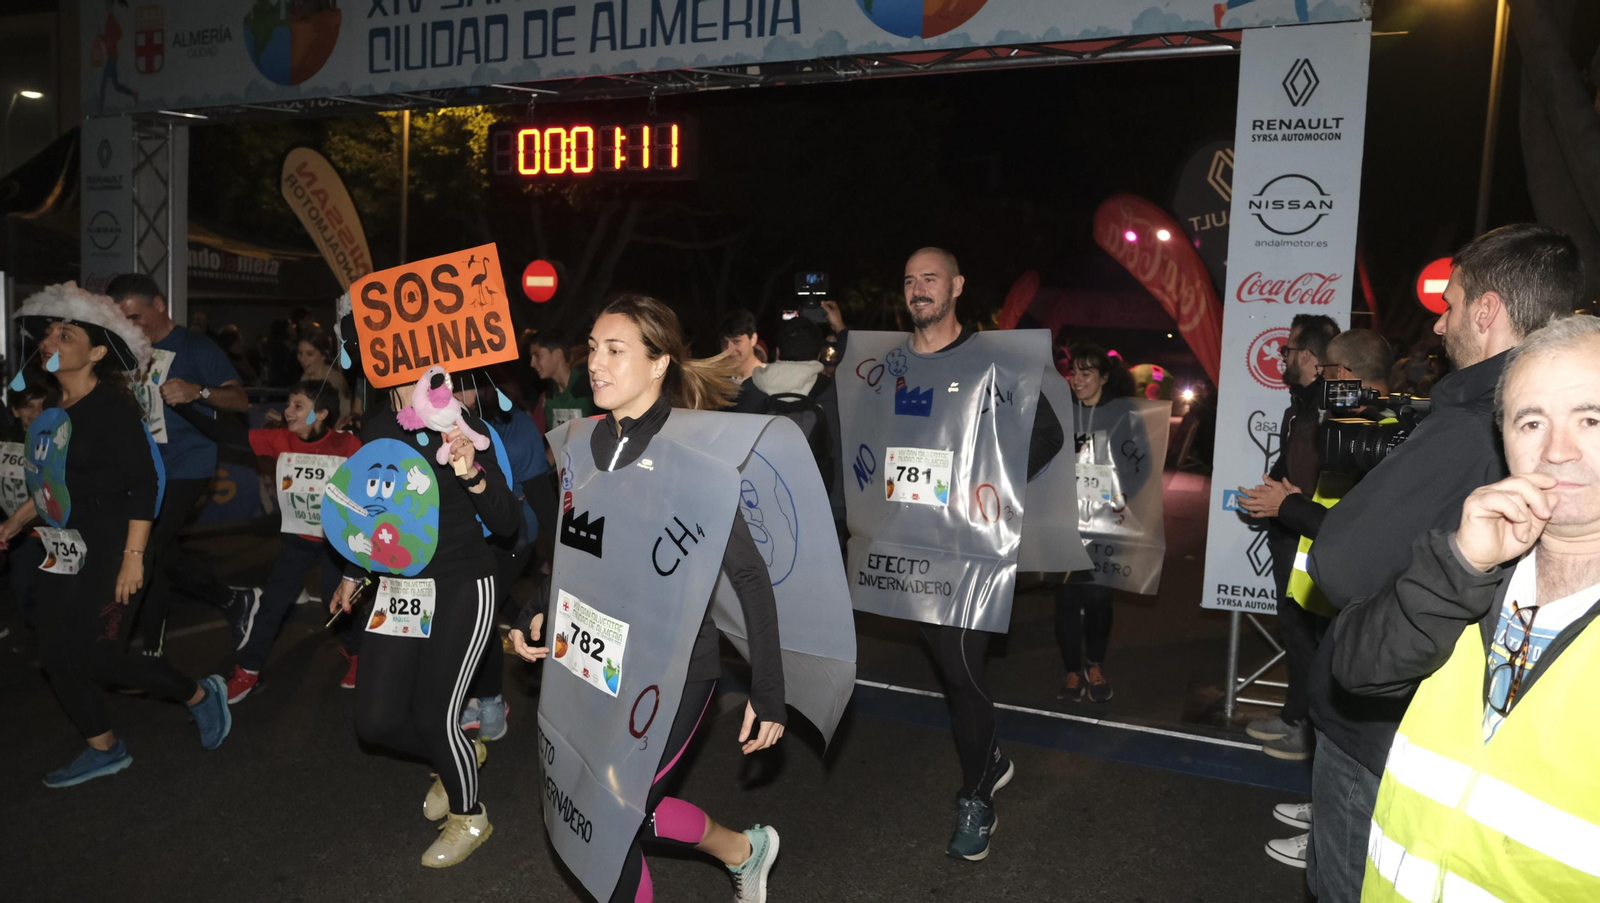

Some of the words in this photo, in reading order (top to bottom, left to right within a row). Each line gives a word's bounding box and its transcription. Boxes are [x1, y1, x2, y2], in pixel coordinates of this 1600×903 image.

[368, 13, 508, 74] CIUDAD
[523, 5, 576, 60] DE
[1252, 117, 1344, 131] RENAULT
[1251, 133, 1279, 142] SYRSA
[1281, 132, 1342, 142] AUTOMOCION
[1248, 199, 1333, 210] NISSAN
[1254, 239, 1328, 248] andalmotor.es
[1236, 271, 1343, 305] Coca-Cola
[360, 263, 465, 332] SOS
[369, 310, 507, 378] SALINAS
[294, 466, 325, 480] 759
[896, 465, 931, 484] 781
[295, 510, 306, 519] ISO
[308, 511, 321, 521] 140
[52, 541, 78, 557] 734
[867, 553, 930, 575] EFECTO
[1092, 562, 1133, 578] DERO
[858, 570, 952, 597] INVERNADERO
[1216, 583, 1277, 600] RENAU
[389, 596, 421, 615] 828
[1216, 597, 1243, 608] SYRSA
[1244, 600, 1277, 611] AUTOM
[570, 622, 605, 663] 782
